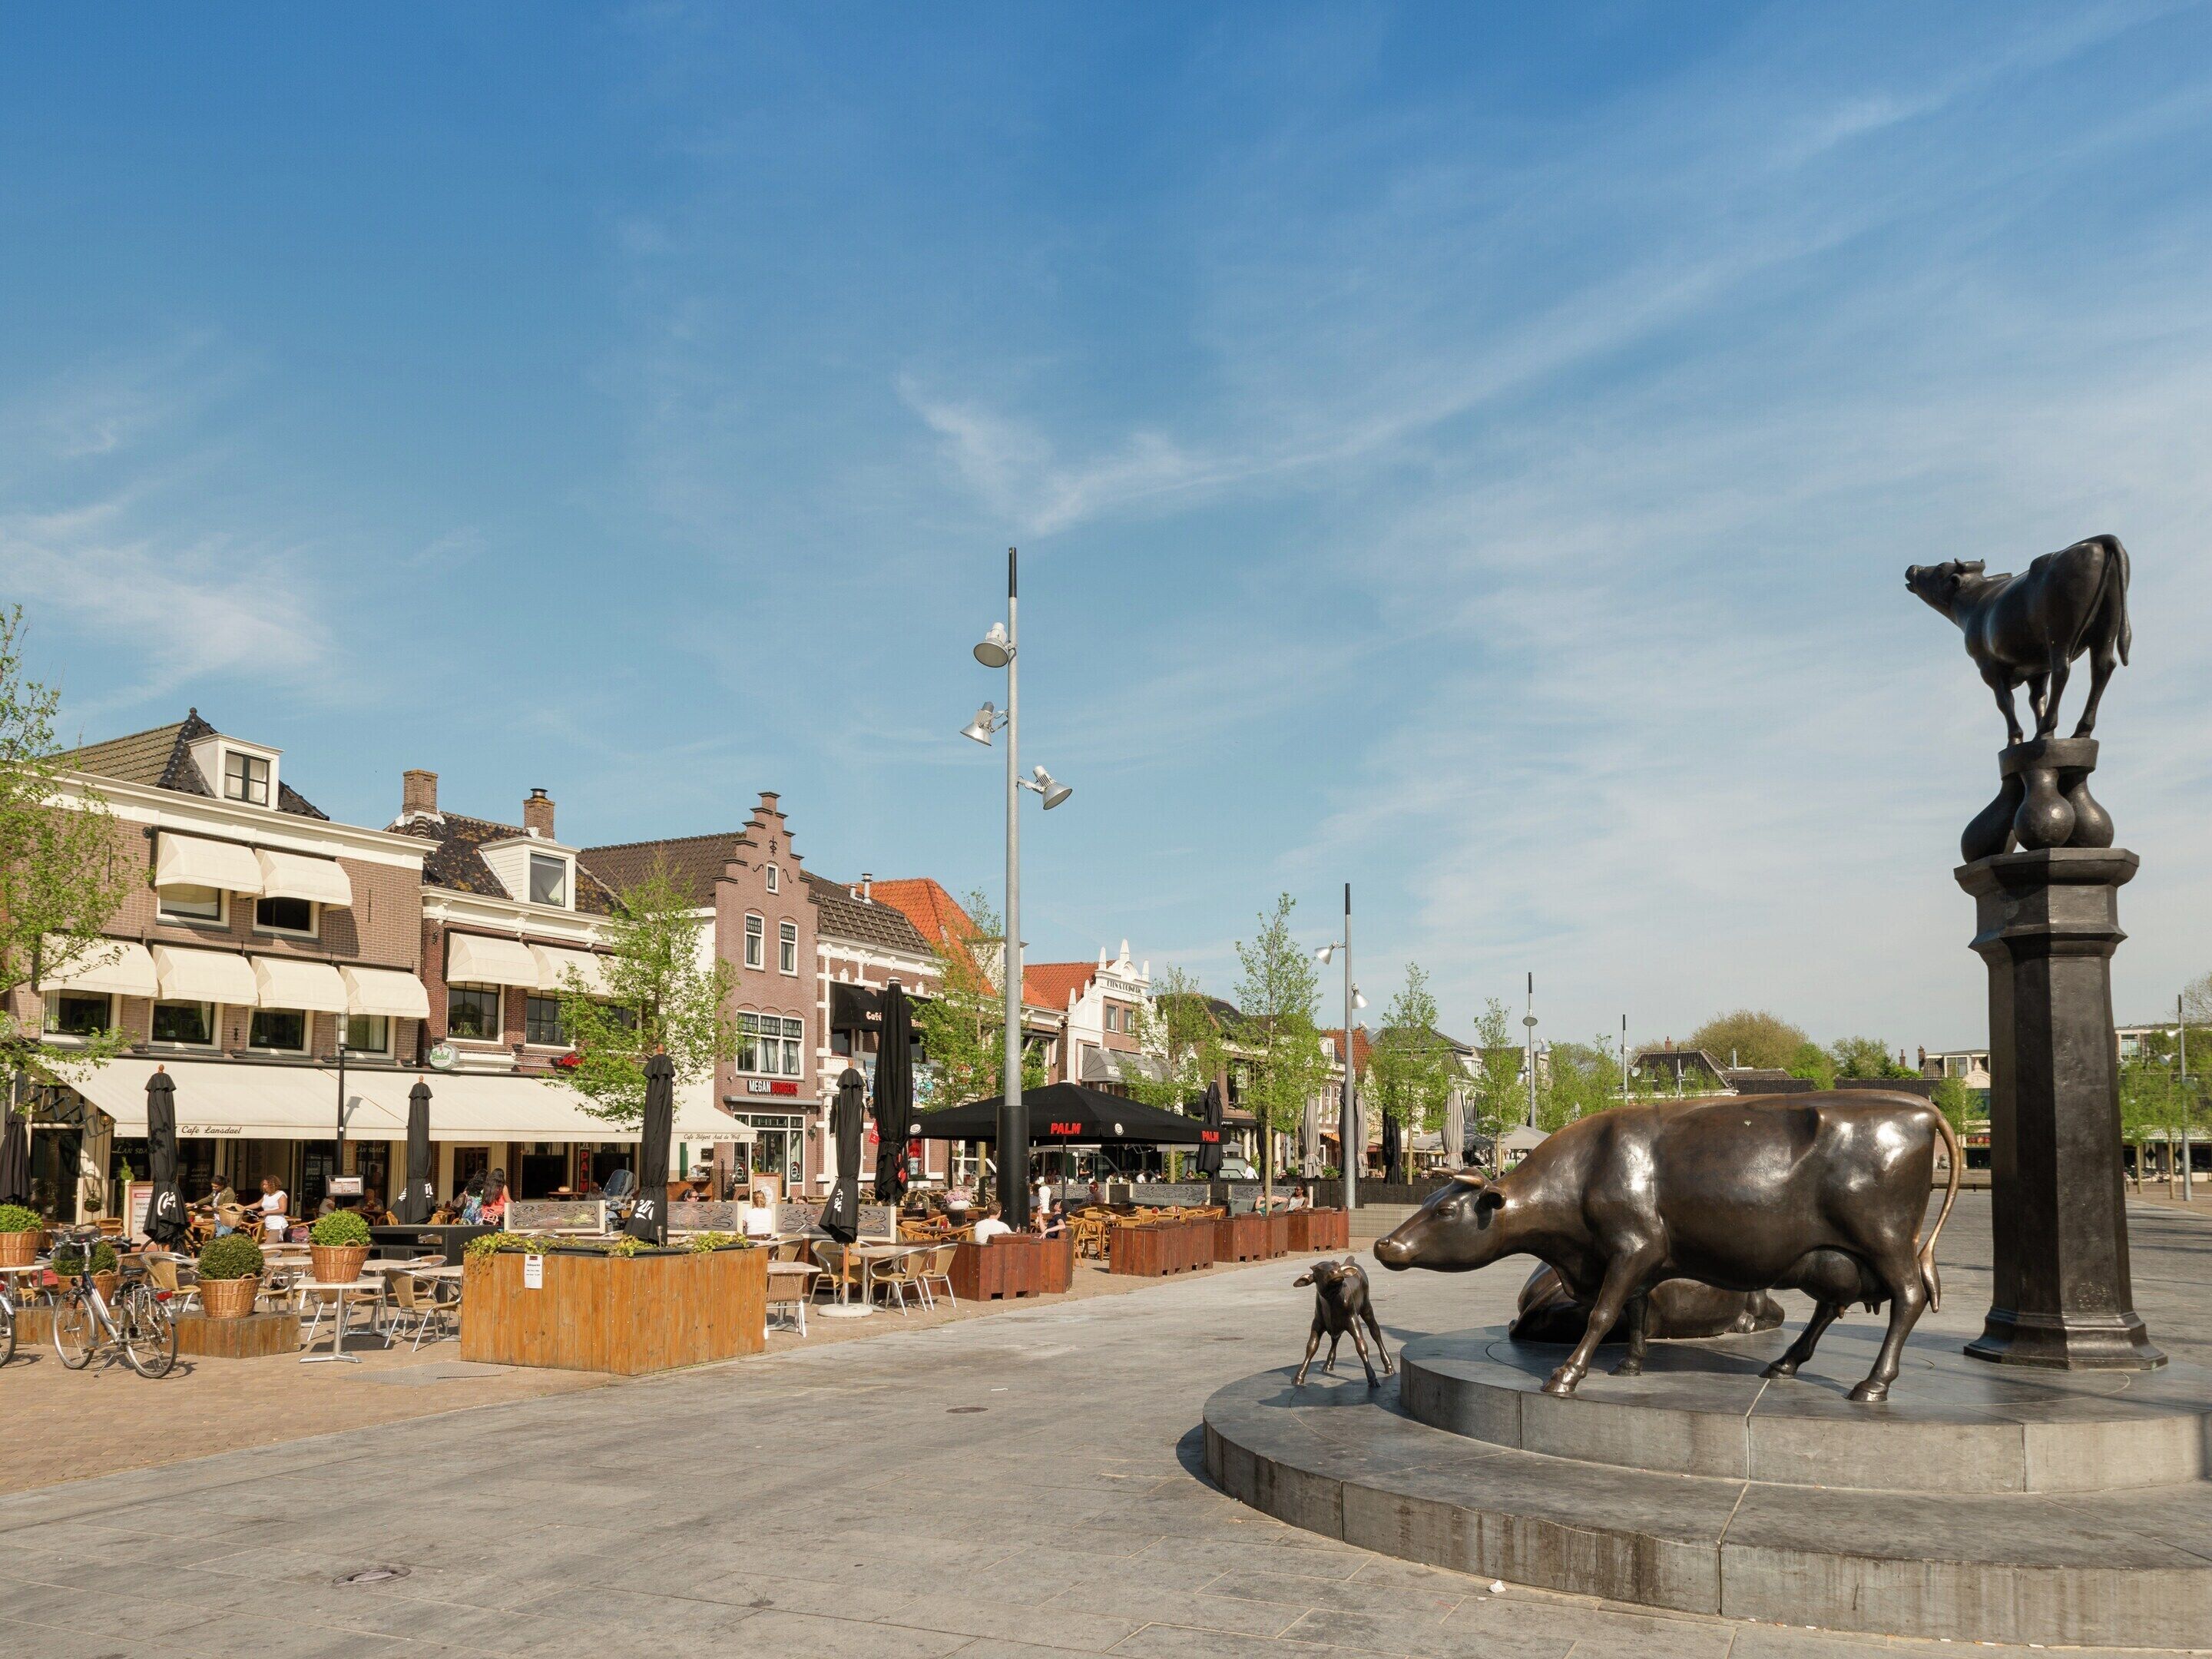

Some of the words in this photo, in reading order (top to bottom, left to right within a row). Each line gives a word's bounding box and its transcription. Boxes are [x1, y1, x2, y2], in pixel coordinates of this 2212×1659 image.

[749, 1080, 771, 1092] MEGAN
[772, 1082, 798, 1095] BURGERS
[1051, 1123, 1081, 1134] PALM
[1201, 1131, 1220, 1142] PALM
[580, 1152, 589, 1191] PALM
